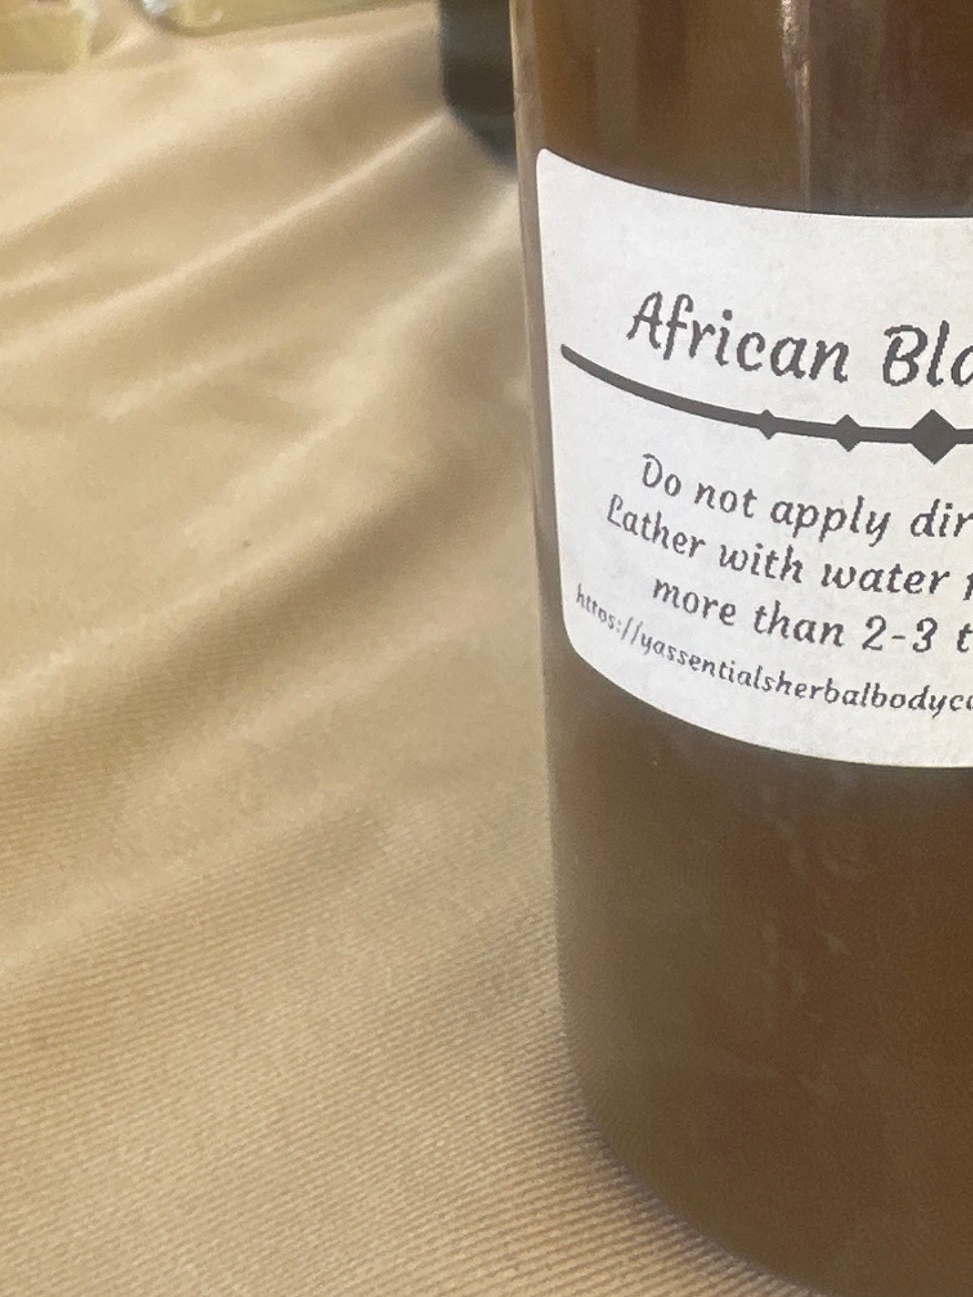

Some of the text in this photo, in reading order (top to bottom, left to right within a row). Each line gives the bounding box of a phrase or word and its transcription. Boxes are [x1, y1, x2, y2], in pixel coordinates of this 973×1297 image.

[625, 290, 850, 384] African
[606, 493, 706, 560] Lather
[718, 542, 804, 584] with
[820, 562, 951, 596] water
[641, 452, 683, 498] Do
[694, 482, 758, 519] not
[769, 495, 892, 549] apply
[652, 578, 737, 627] more
[753, 599, 845, 648] than
[861, 614, 939, 654] 2-3
